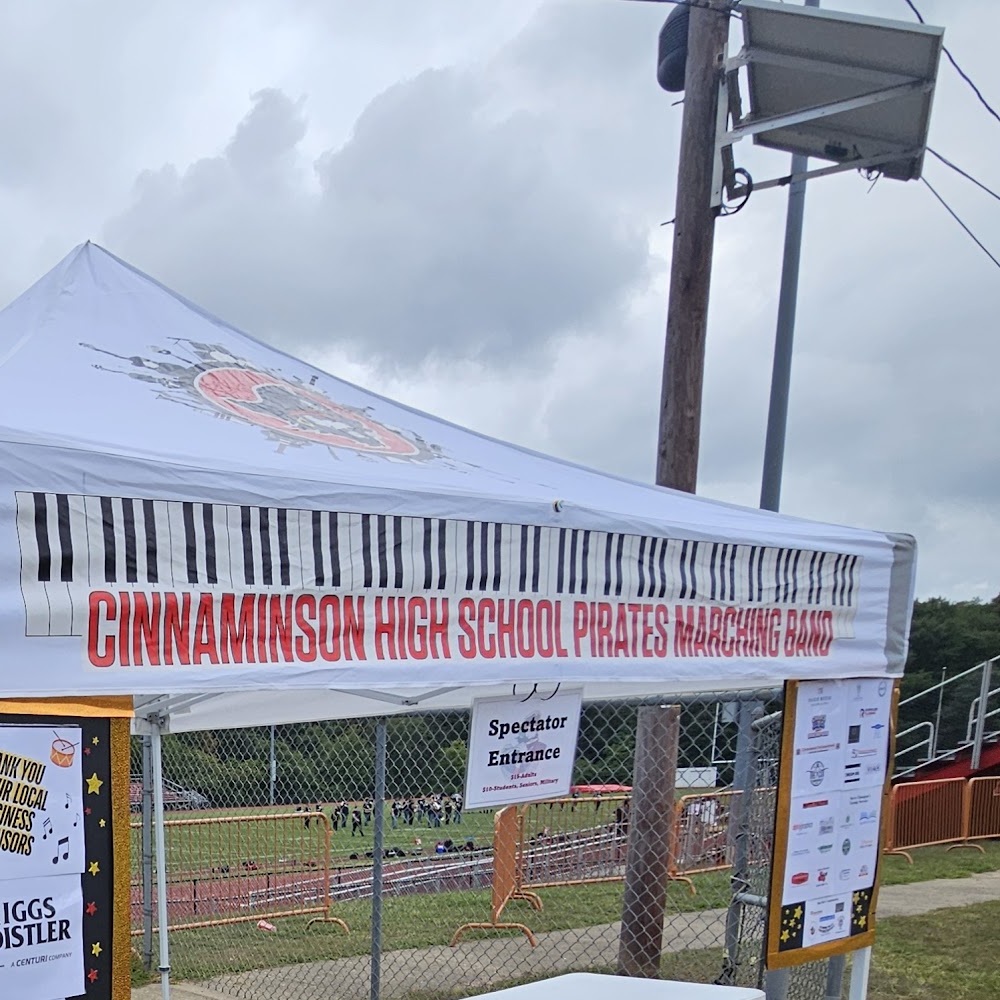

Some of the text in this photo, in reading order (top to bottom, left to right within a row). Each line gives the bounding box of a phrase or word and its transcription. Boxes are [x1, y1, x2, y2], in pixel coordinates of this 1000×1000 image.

[87, 590, 834, 668] CINNAMINSON HIGH SCHOOL PIRATES MARCHING BAND
[488, 715, 568, 739] Spectator
[487, 747, 560, 767] Entrance
[21, 760, 47, 785] YOU
[12, 782, 49, 811] LOCAL
[16, 954, 48, 967] CENTURI
[48, 952, 73, 961] COMPANY
